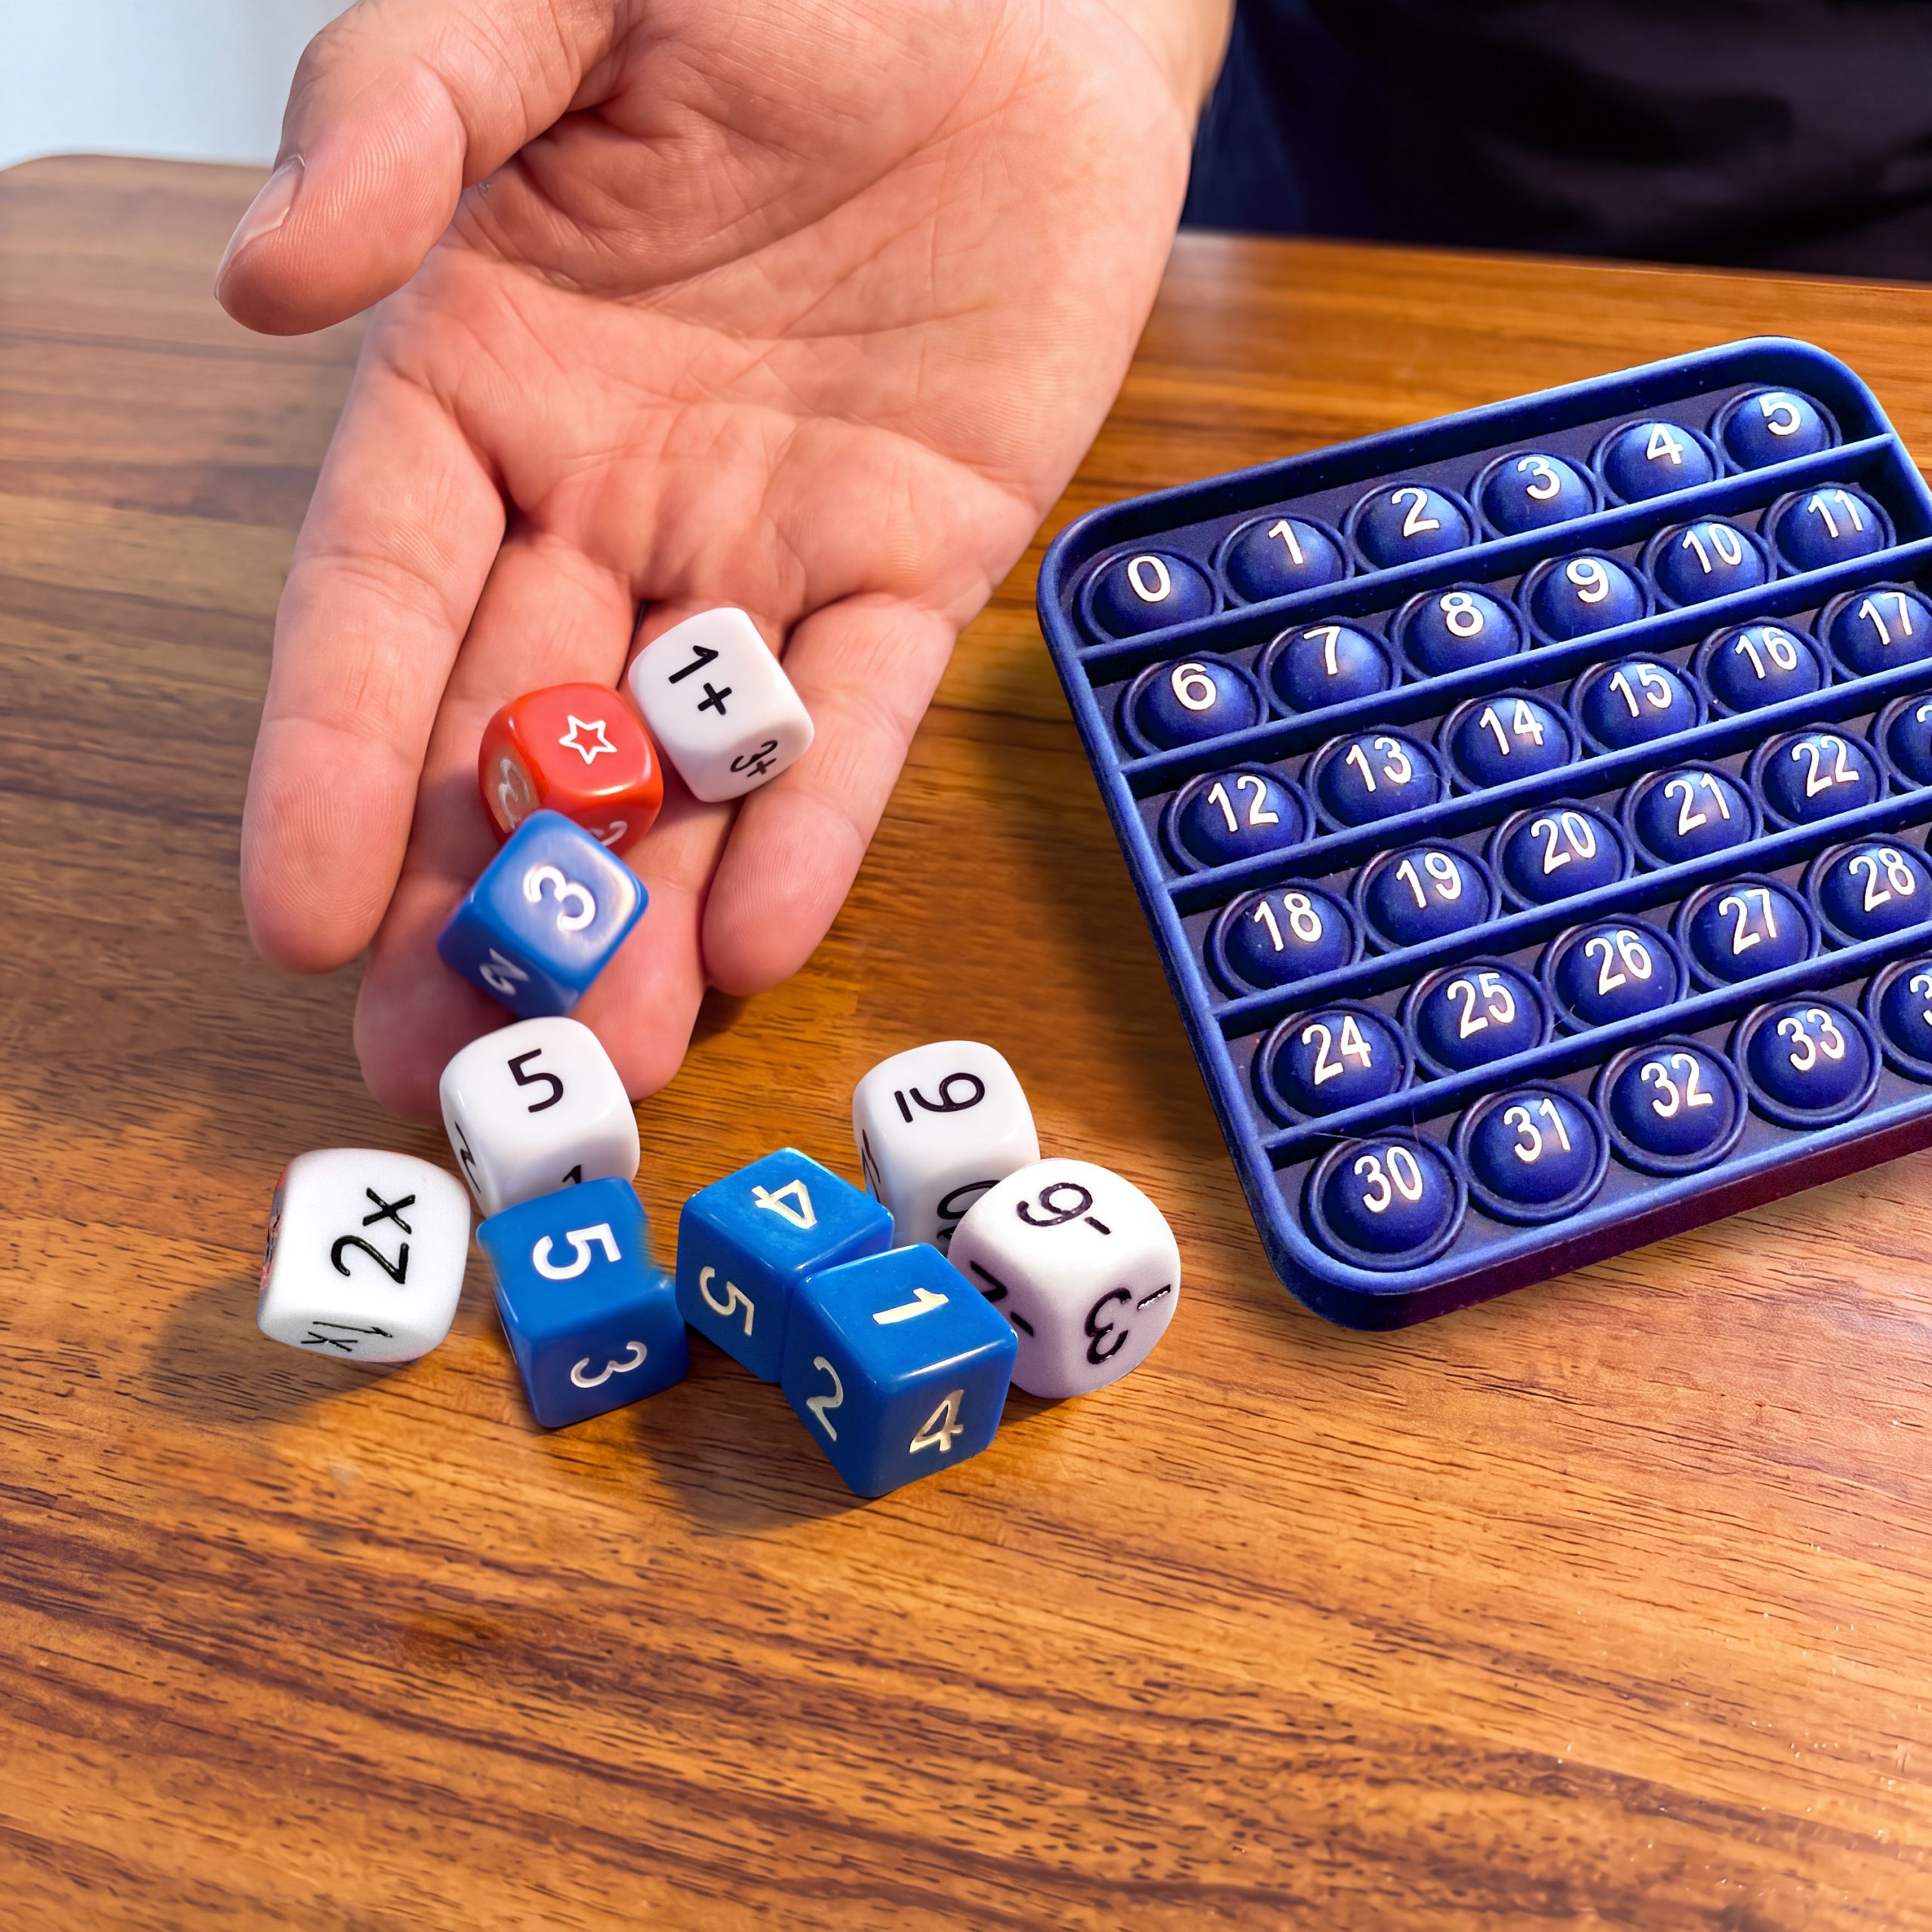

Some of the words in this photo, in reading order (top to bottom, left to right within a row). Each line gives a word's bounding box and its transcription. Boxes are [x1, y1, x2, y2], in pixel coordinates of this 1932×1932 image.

[1128, 555, 1171, 602] 0
[1268, 520, 1304, 565] 1
[1391, 488, 1440, 537] 2
[1517, 456, 1561, 500] 3
[1647, 423, 1684, 465] 4
[1758, 392, 1801, 435] 5
[1171, 663, 1217, 710] 6
[1303, 626, 1341, 675] 7
[1440, 592, 1484, 637] 8
[1566, 557, 1609, 603] 9
[1682, 523, 1742, 574] 10
[1807, 489, 1863, 538] 11
[1208, 775, 1279, 832] 12
[1346, 737, 1412, 792] 13
[1479, 700, 1543, 755] 14
[1610, 663, 1672, 717] 15
[1735, 626, 1797, 678] 16
[1859, 592, 1913, 645] 17
[1254, 893, 1322, 951] 18
[1396, 852, 1462, 908] 19
[1531, 811, 1597, 874] 20
[1664, 773, 1730, 835] 21
[1792, 735, 1860, 797] 22
[523, 865, 596, 932] 3
[1302, 1016, 1372, 1085] 24
[1447, 972, 1515, 1039] 25
[1585, 930, 1652, 995] 26
[1718, 888, 1777, 955] 27
[1848, 848, 1915, 912] 28
[507, 1048, 565, 1113] 5
[1354, 1146, 1423, 1213] 30
[1503, 1098, 1571, 1162] 31
[1641, 1054, 1713, 1117] 32
[1777, 1008, 1845, 1071] 33
[751, 1179, 817, 1229] 4
[532, 1223, 622, 1281] 5
[699, 1266, 755, 1337] 5
[872, 1287, 949, 1325] 1
[570, 1340, 648, 1389] 3
[806, 1356, 844, 1441] 2
[909, 1389, 964, 1453] 4
